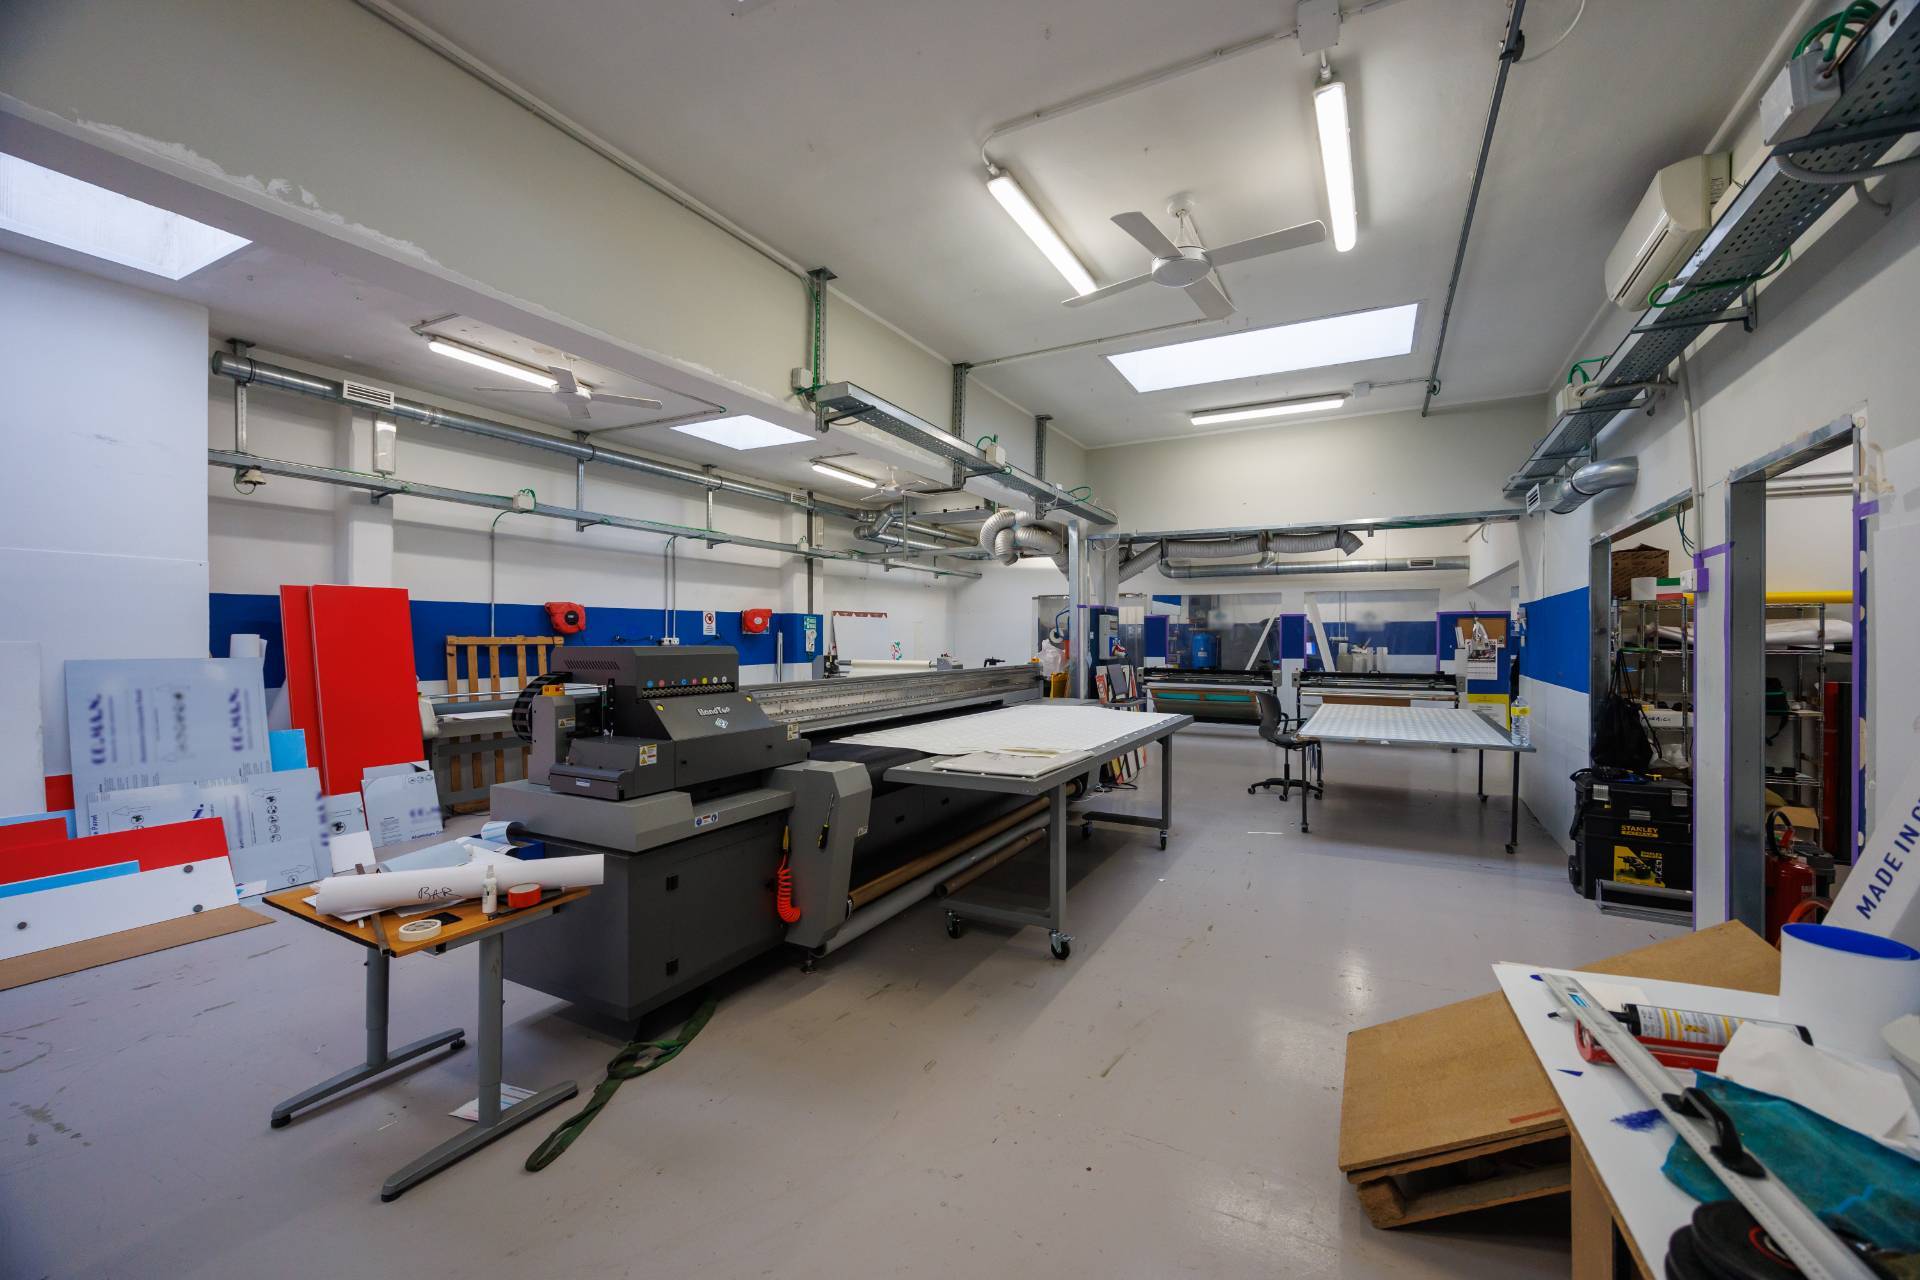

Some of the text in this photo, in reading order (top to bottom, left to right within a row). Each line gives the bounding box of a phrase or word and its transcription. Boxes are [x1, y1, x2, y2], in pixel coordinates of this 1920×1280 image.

[1620, 824, 1659, 834] STANLEY
[1856, 852, 1903, 920] MADE
[1894, 824, 1920, 854] IN
[418, 886, 462, 899] BAR
